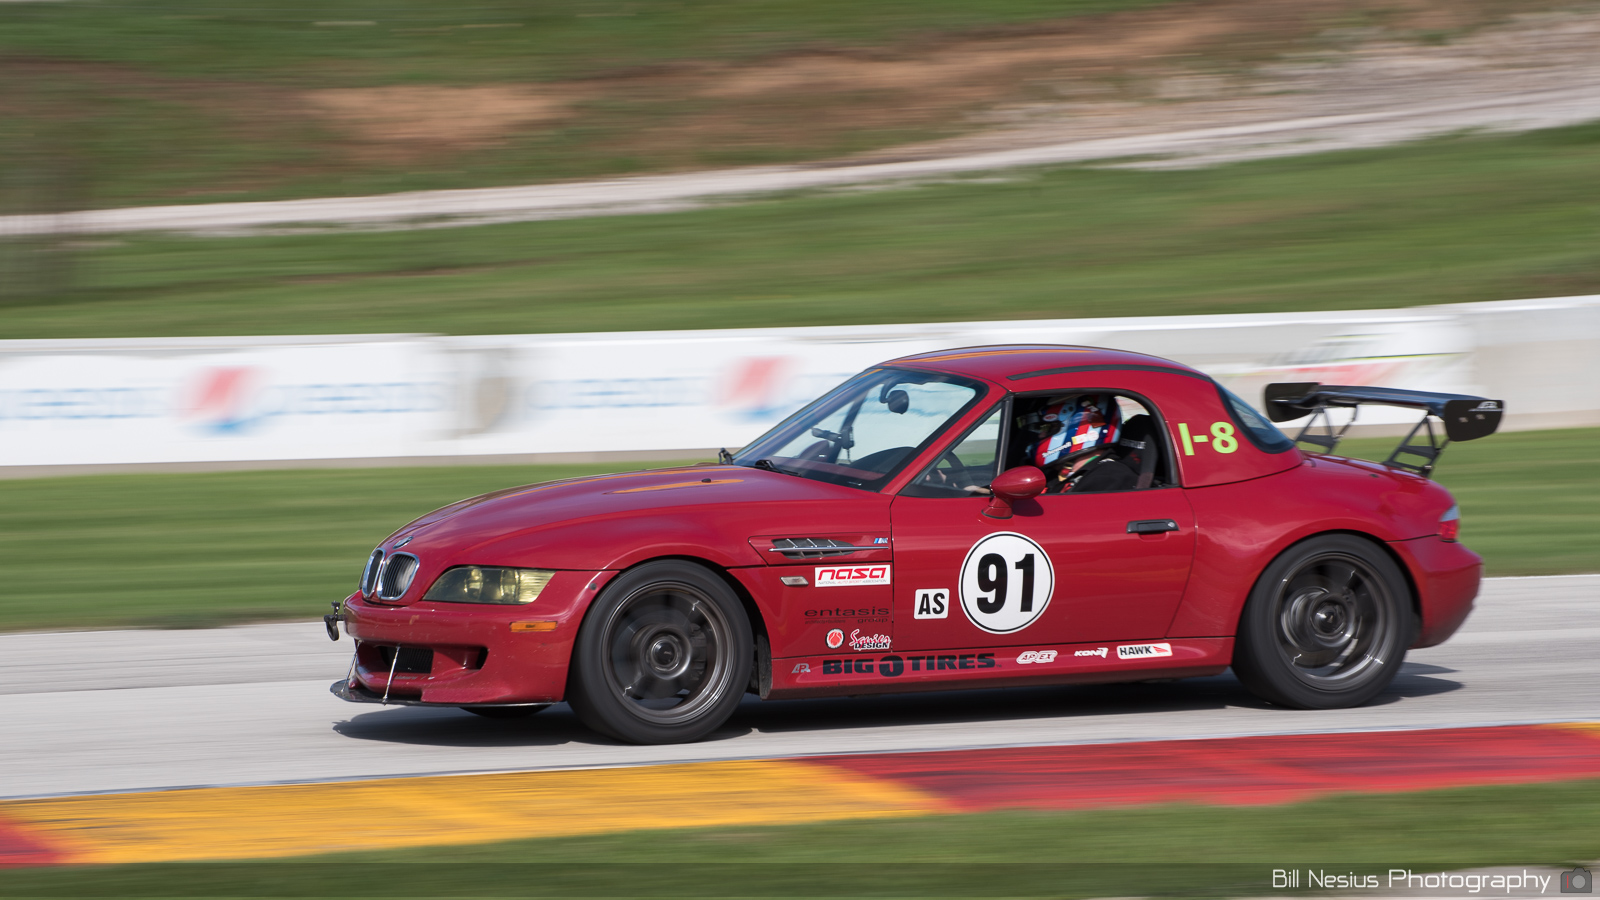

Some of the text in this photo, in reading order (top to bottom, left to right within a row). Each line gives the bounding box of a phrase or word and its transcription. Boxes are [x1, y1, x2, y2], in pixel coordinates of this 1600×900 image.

[1177, 421, 1239, 456] I-8
[976, 552, 1035, 614] 91
[804, 606, 890, 617] entasis
[917, 592, 946, 615] AS
[1018, 652, 1055, 663] APEX
[1119, 645, 1152, 656] HAWK
[822, 653, 996, 677] BIG O TIRES
